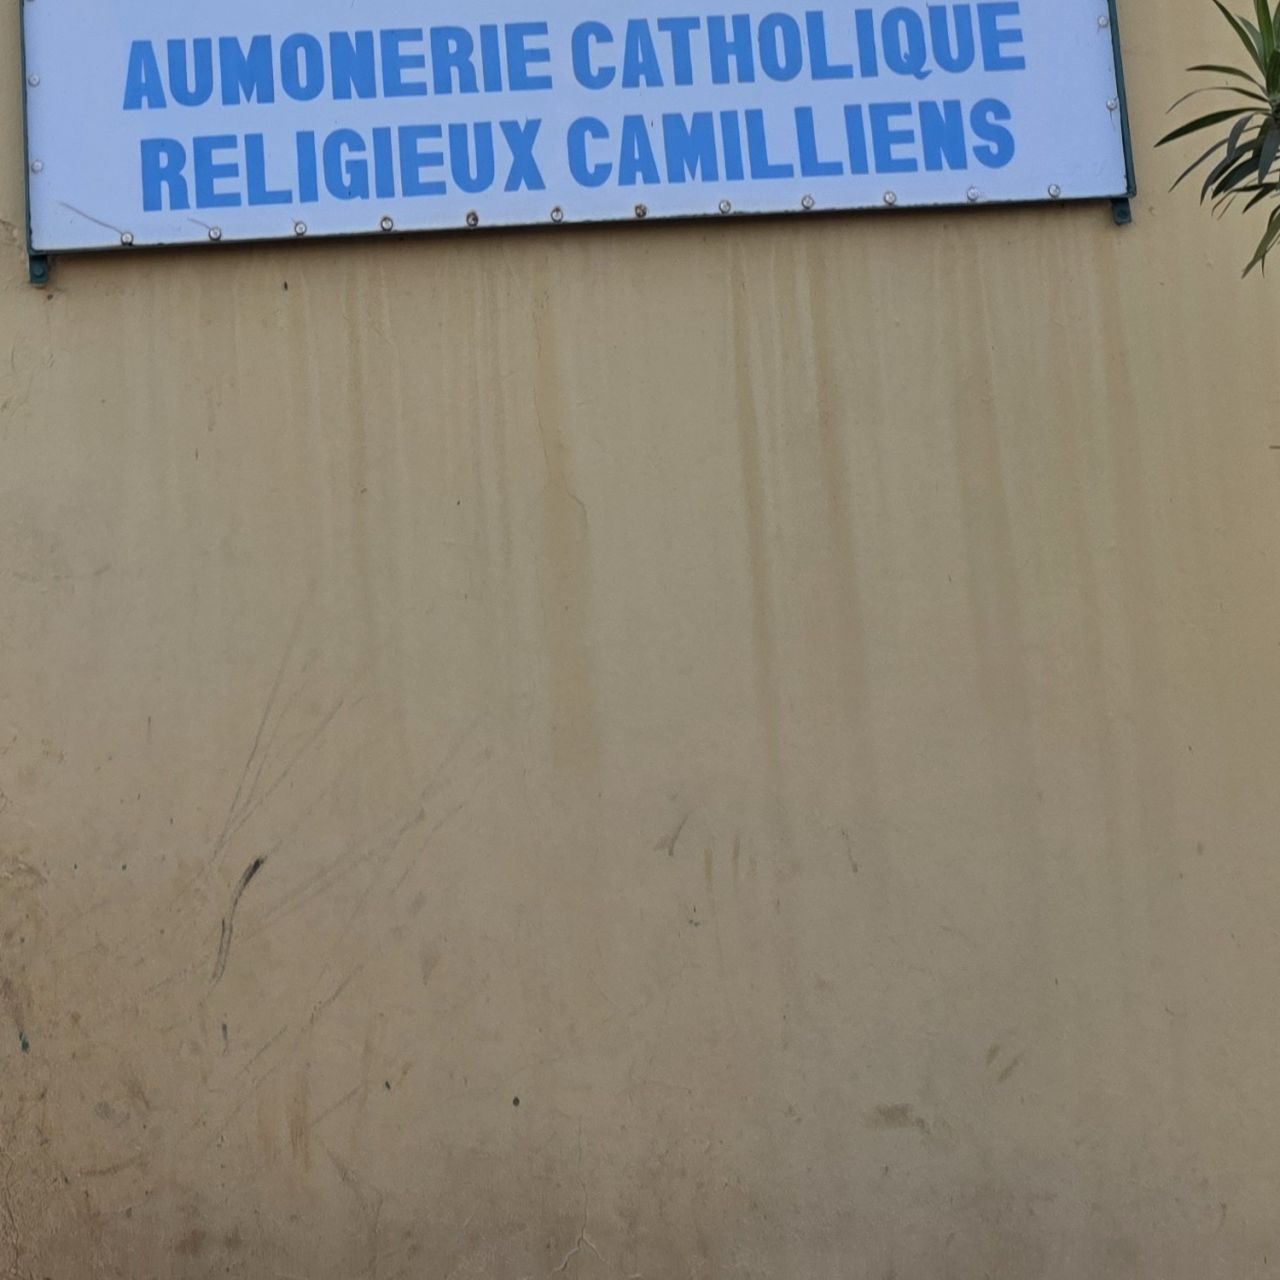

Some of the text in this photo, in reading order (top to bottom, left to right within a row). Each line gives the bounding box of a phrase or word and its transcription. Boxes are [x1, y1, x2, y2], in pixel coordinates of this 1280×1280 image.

[122, 0, 1027, 112] AUMONERIE CATHOLIQUE
[139, 96, 1016, 213] RELIGIEUX CAMILLIENS
